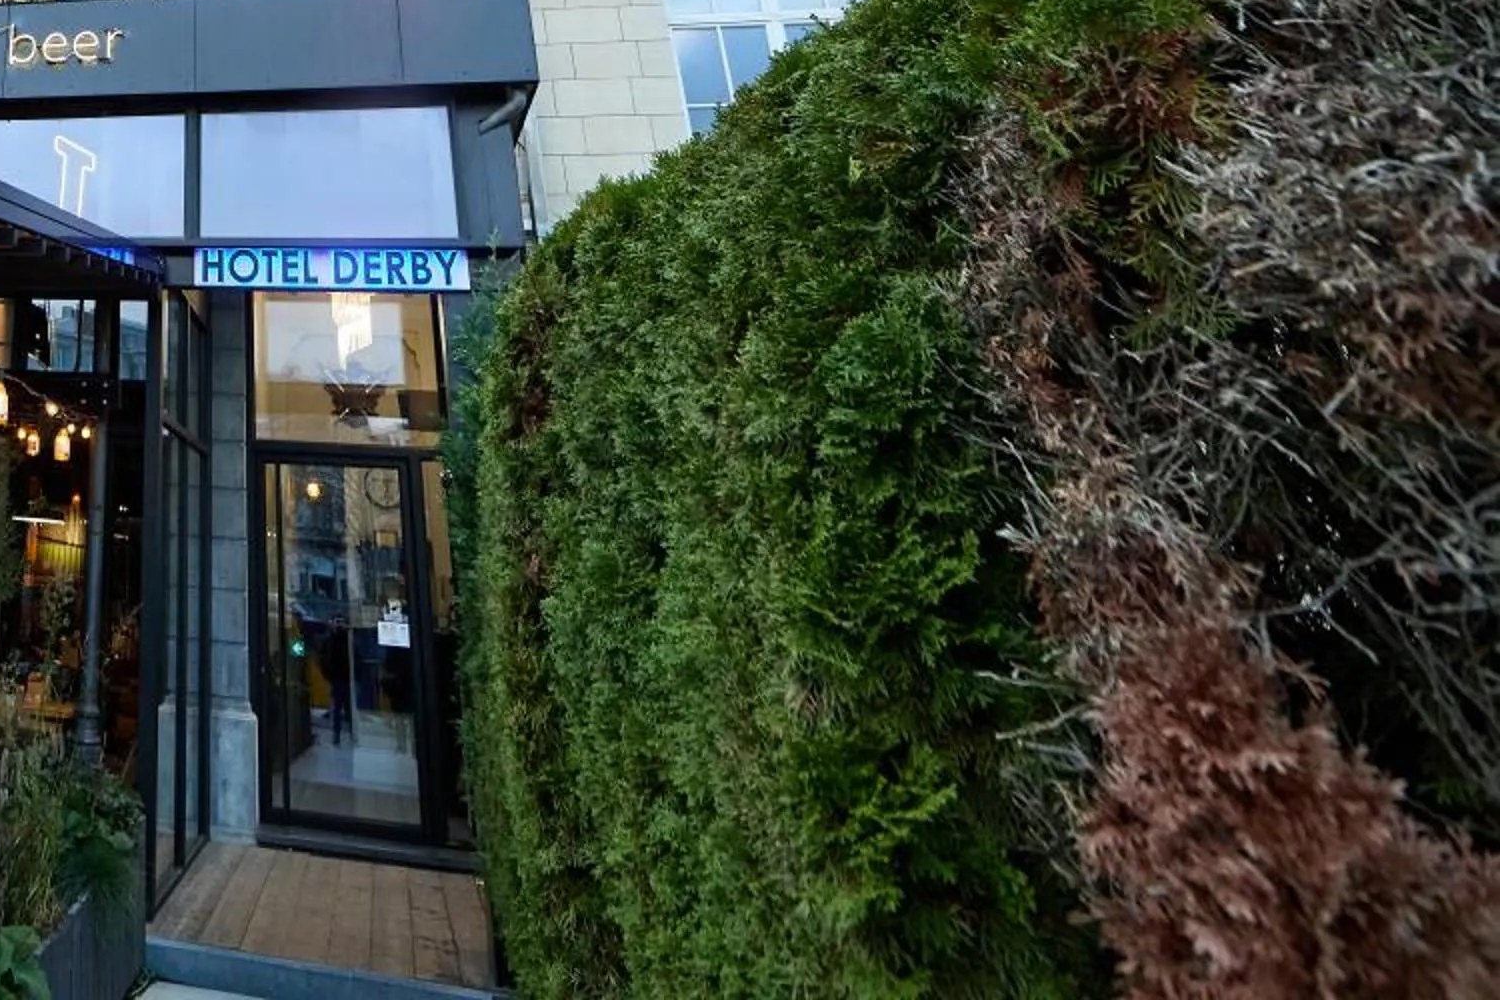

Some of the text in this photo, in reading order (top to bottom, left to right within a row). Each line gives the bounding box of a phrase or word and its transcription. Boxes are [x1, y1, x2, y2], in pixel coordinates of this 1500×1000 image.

[9, 23, 124, 66] beer
[200, 249, 458, 287] HOTEL DERBY
